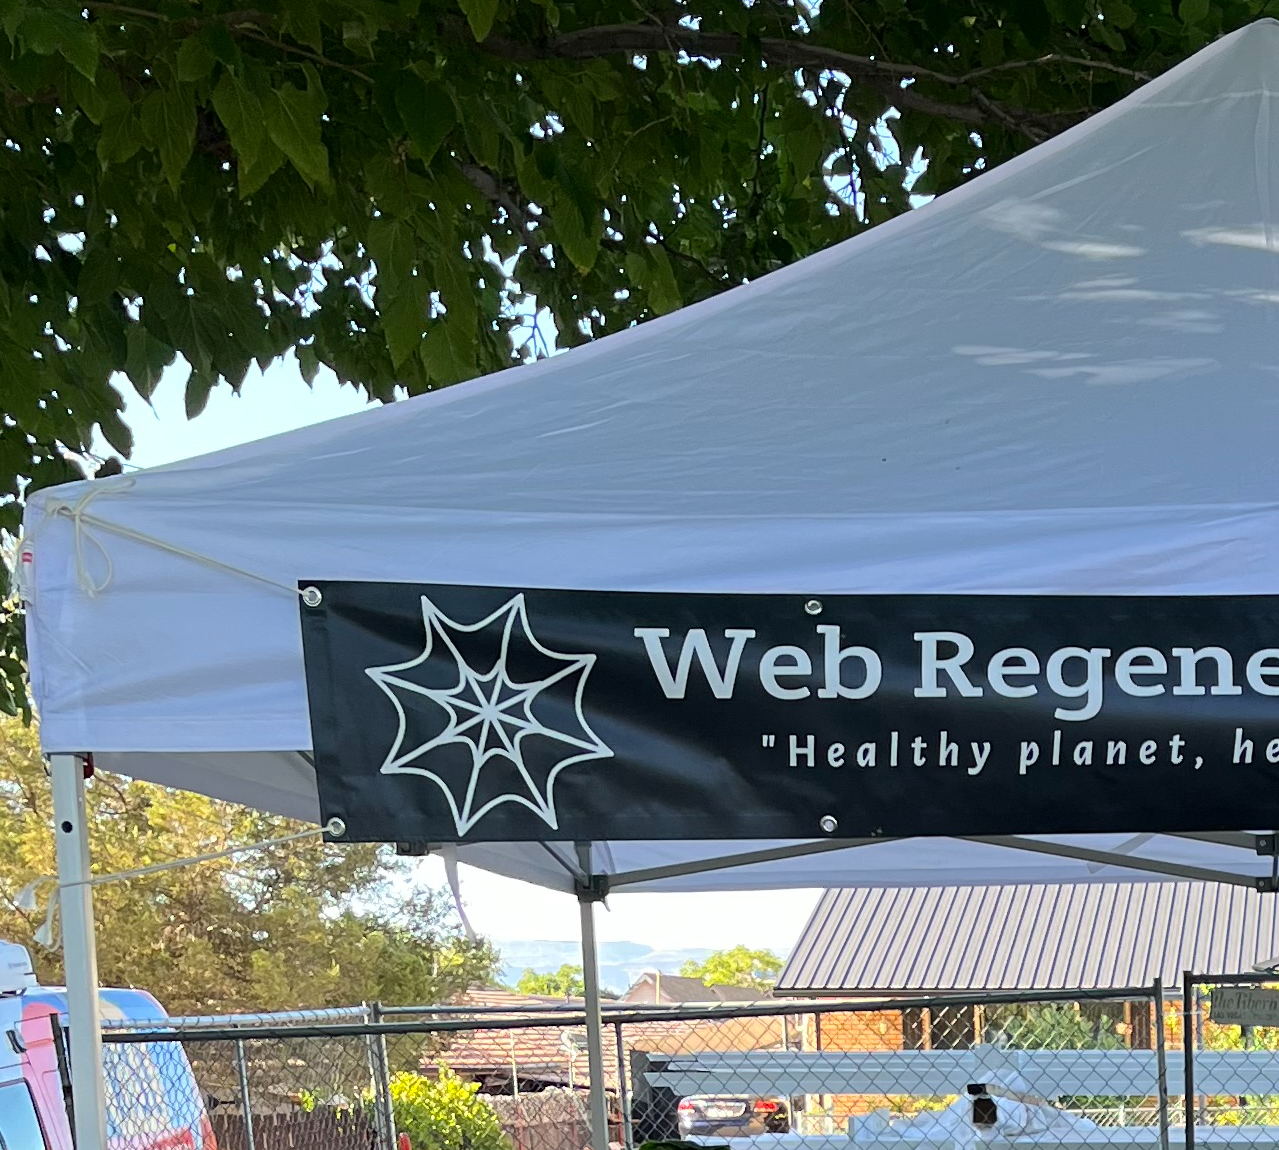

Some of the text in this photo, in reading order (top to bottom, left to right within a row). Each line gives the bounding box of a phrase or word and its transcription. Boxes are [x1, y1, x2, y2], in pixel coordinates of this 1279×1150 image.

[634, 624, 882, 700] Web
[762, 731, 991, 776] "Healthy
[1019, 730, 1203, 775] planet,
